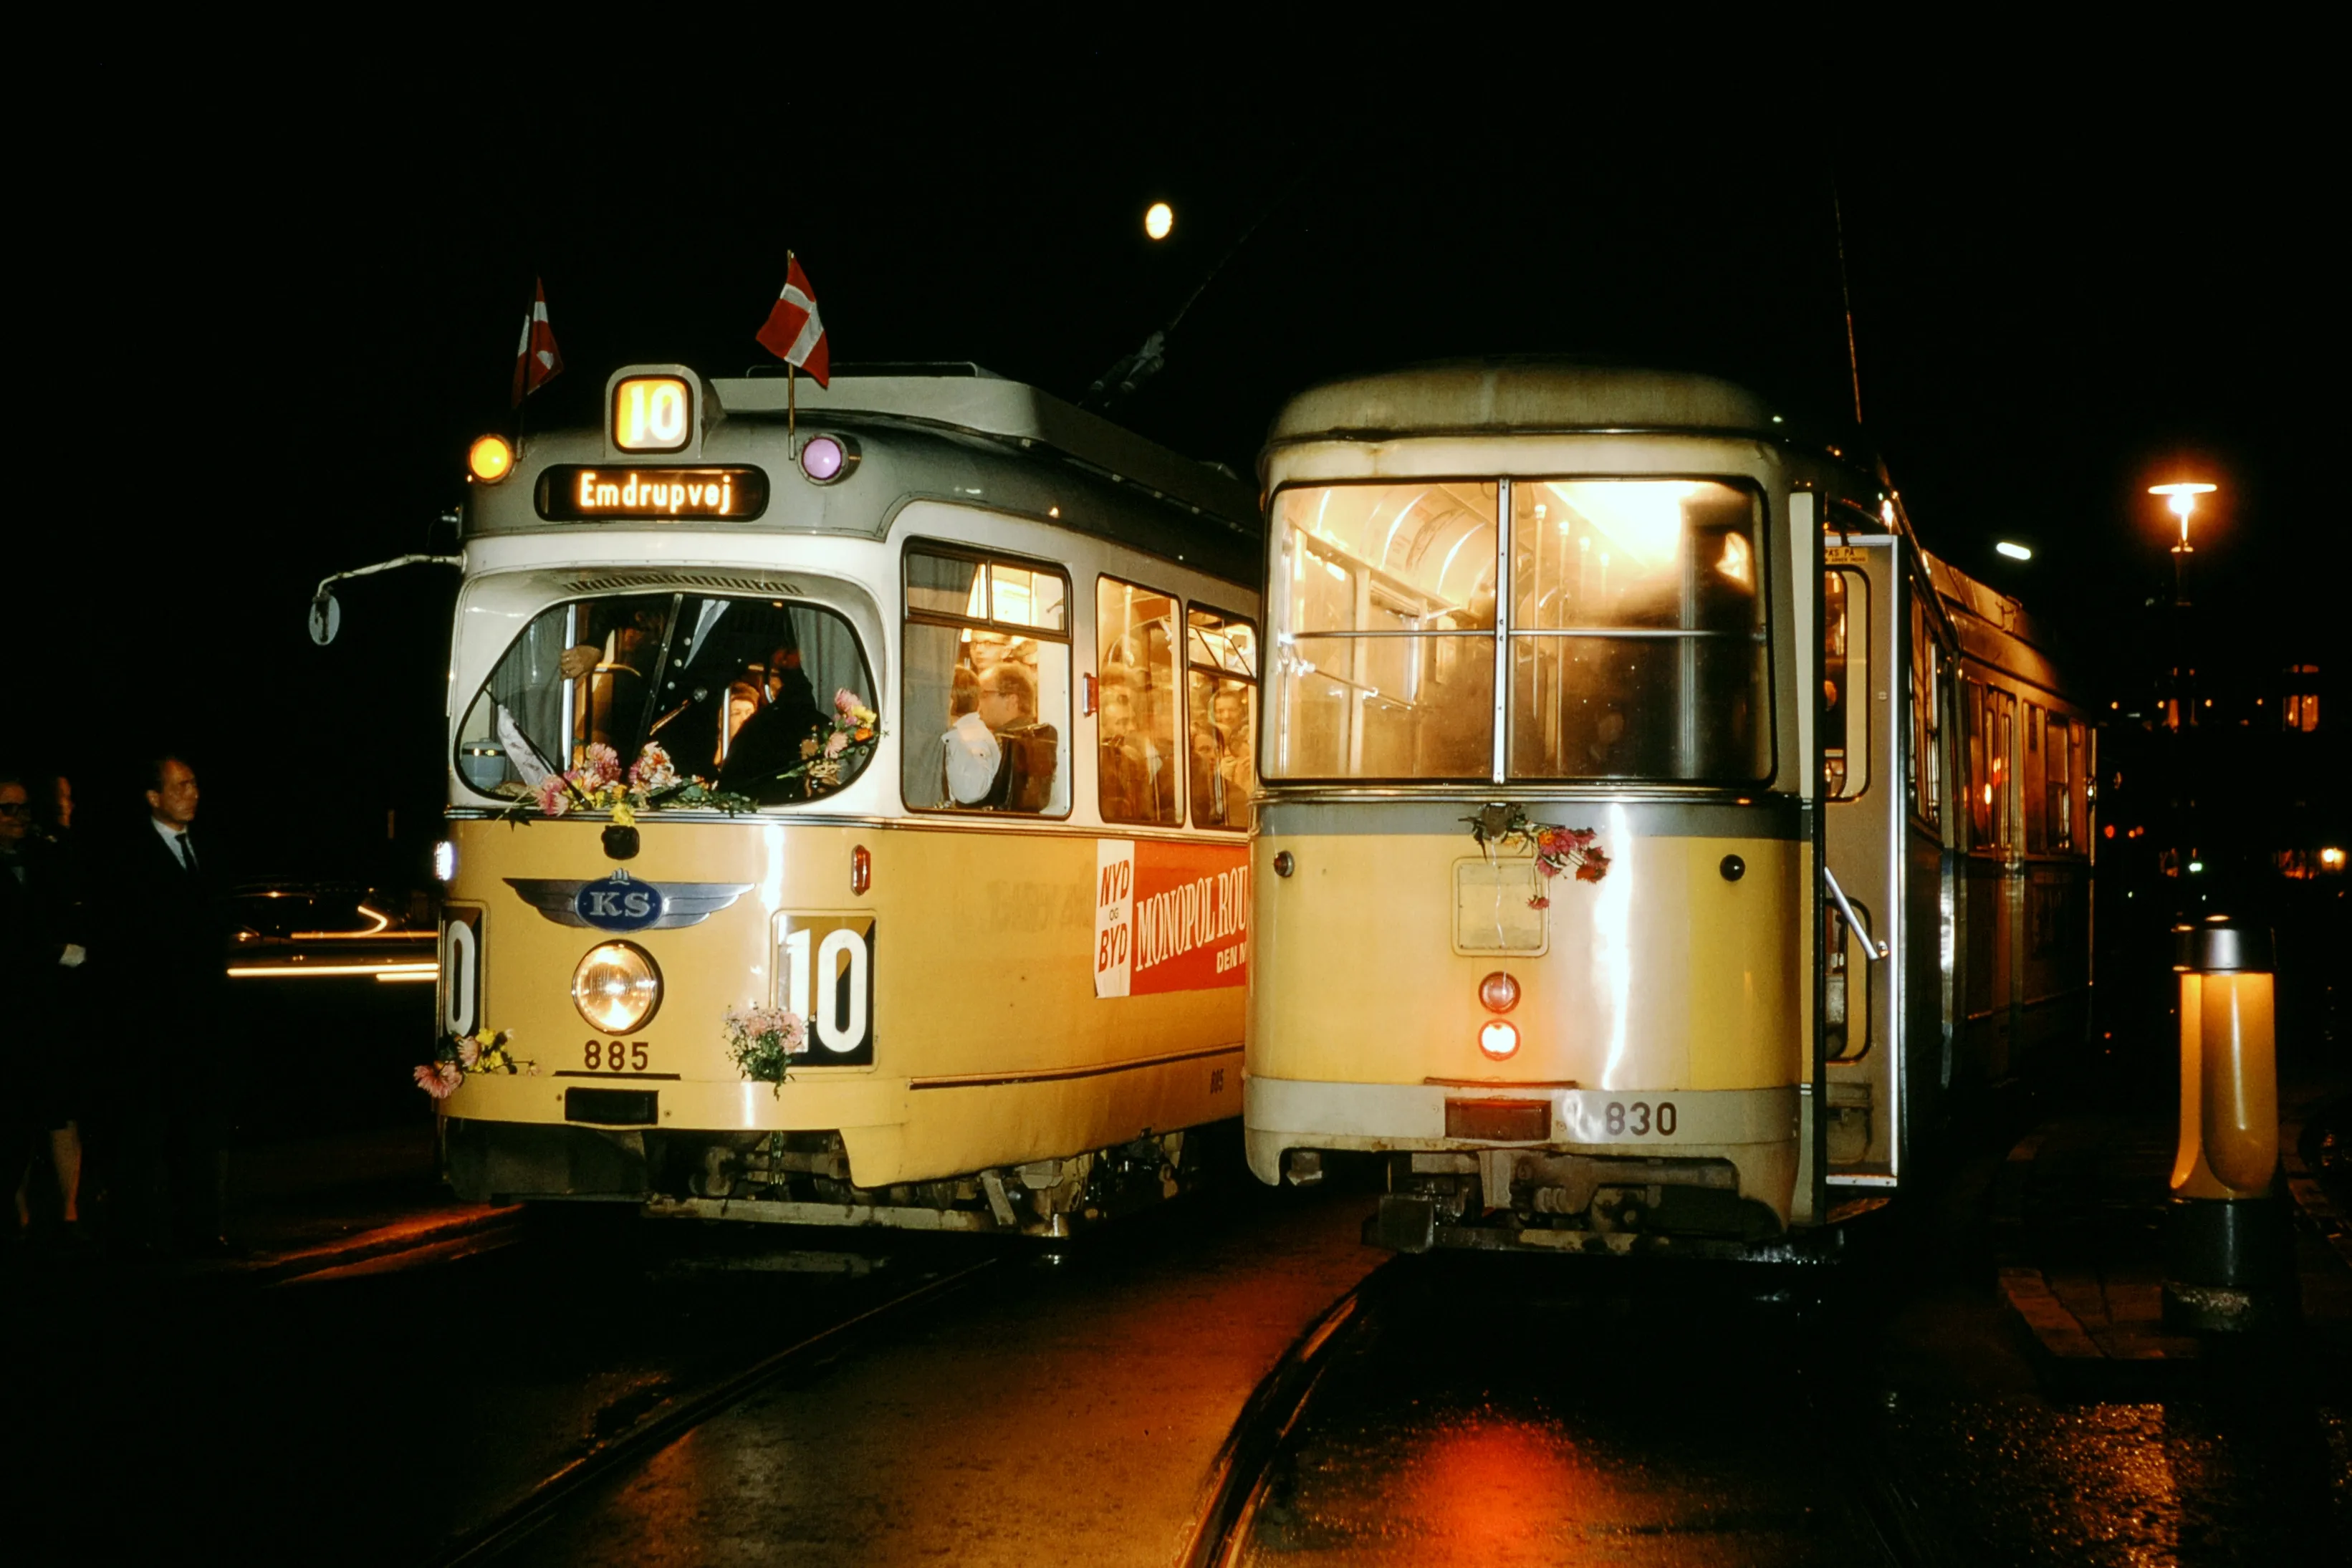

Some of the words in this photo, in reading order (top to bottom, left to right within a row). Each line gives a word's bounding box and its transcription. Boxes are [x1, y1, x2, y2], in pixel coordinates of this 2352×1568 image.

[630, 385, 683, 442] 10
[580, 472, 732, 515] Emdrupvej
[589, 890, 651, 918] KS
[1100, 860, 1130, 908] NYD
[1109, 908, 1119, 920] OG
[1136, 877, 1216, 972] MONOPOL
[1098, 923, 1128, 973] BYD
[1216, 948, 1237, 973] DEN
[786, 928, 868, 1054] 10
[584, 1039, 650, 1072] 885
[1605, 1101, 1677, 1137] 830
